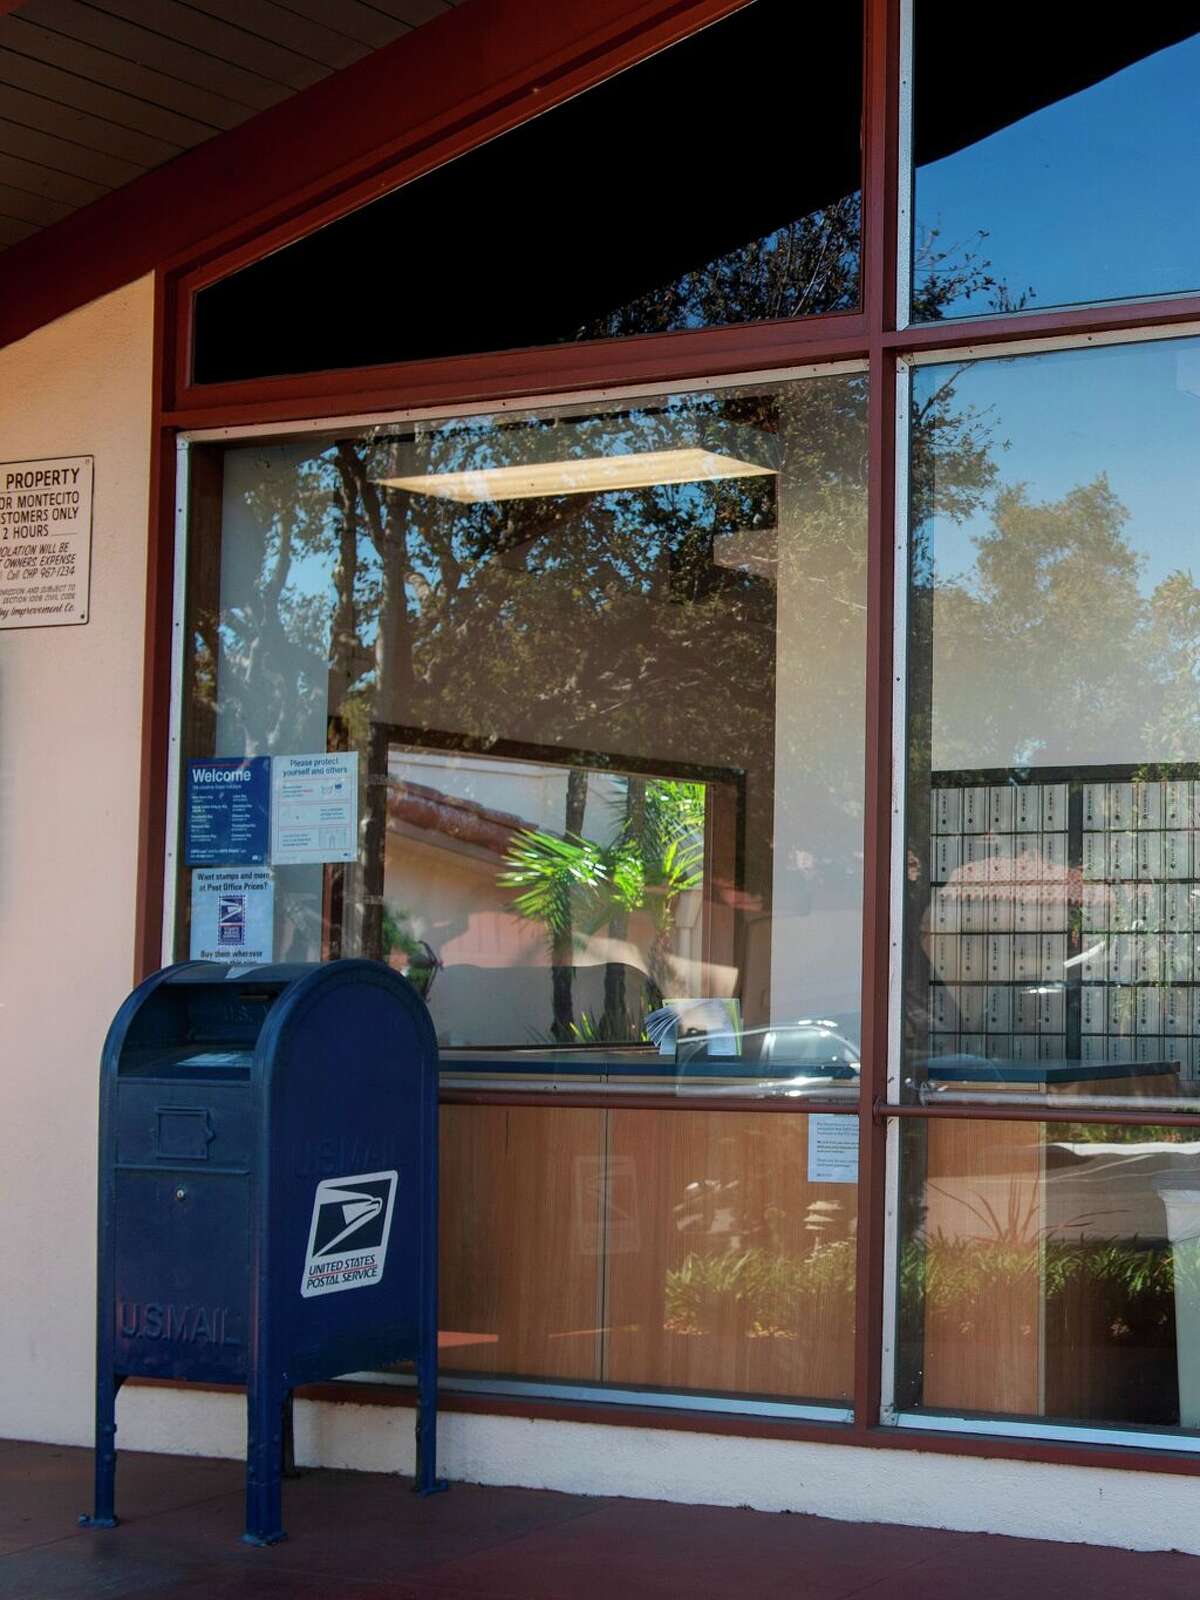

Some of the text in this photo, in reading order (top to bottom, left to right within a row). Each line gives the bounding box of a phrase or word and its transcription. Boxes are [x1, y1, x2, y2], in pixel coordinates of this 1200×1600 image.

[6, 467, 80, 489] PROPERTY
[17, 490, 80, 508] MONTECITO
[52, 506, 79, 520] ONLY
[3, 524, 49, 540] 2 HOURS
[59, 542, 70, 553] BE
[4, 556, 38, 569] OWNERS
[40, 553, 77, 567] EXPENSE
[290, 757, 339, 769] Please protect
[192, 768, 251, 783] Welcome
[282, 766, 348, 778] yourself and others
[197, 873, 214, 881] Want
[216, 872, 239, 882] stamps
[240, 872, 253, 880] and
[207, 883, 222, 892] Post
[223, 882, 242, 892] Office
[243, 881, 268, 891] Prices?
[308, 1254, 376, 1276] UNITED STATES
[306, 1266, 378, 1290] POSTAL SERVICE
